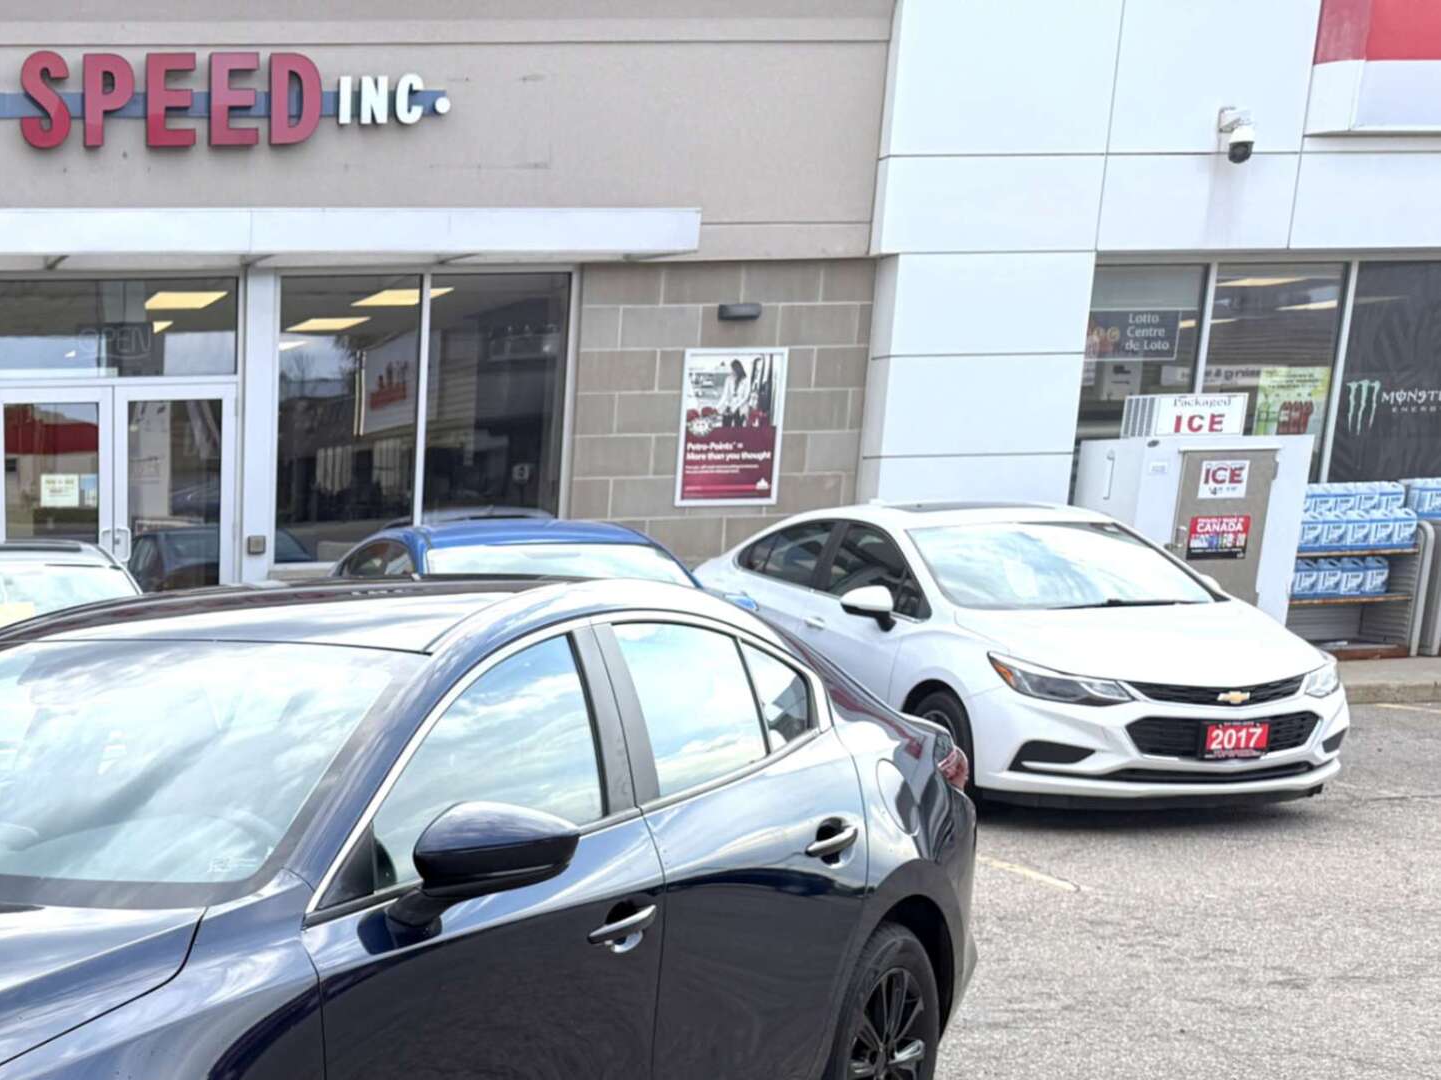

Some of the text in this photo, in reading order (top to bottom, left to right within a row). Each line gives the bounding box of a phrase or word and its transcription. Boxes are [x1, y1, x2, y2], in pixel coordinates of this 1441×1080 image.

[20, 50, 323, 150] SPEED
[338, 73, 451, 125] INC.
[1128, 313, 1160, 324] Lotto
[1126, 326, 1166, 338] Centre
[1125, 340, 1170, 351] de Loto
[1174, 397, 1231, 409] Packaged
[1174, 413, 1225, 433] ICE
[1204, 466, 1245, 485] ICE
[1196, 522, 1244, 532] CANADA
[1210, 728, 1263, 750] 2017
